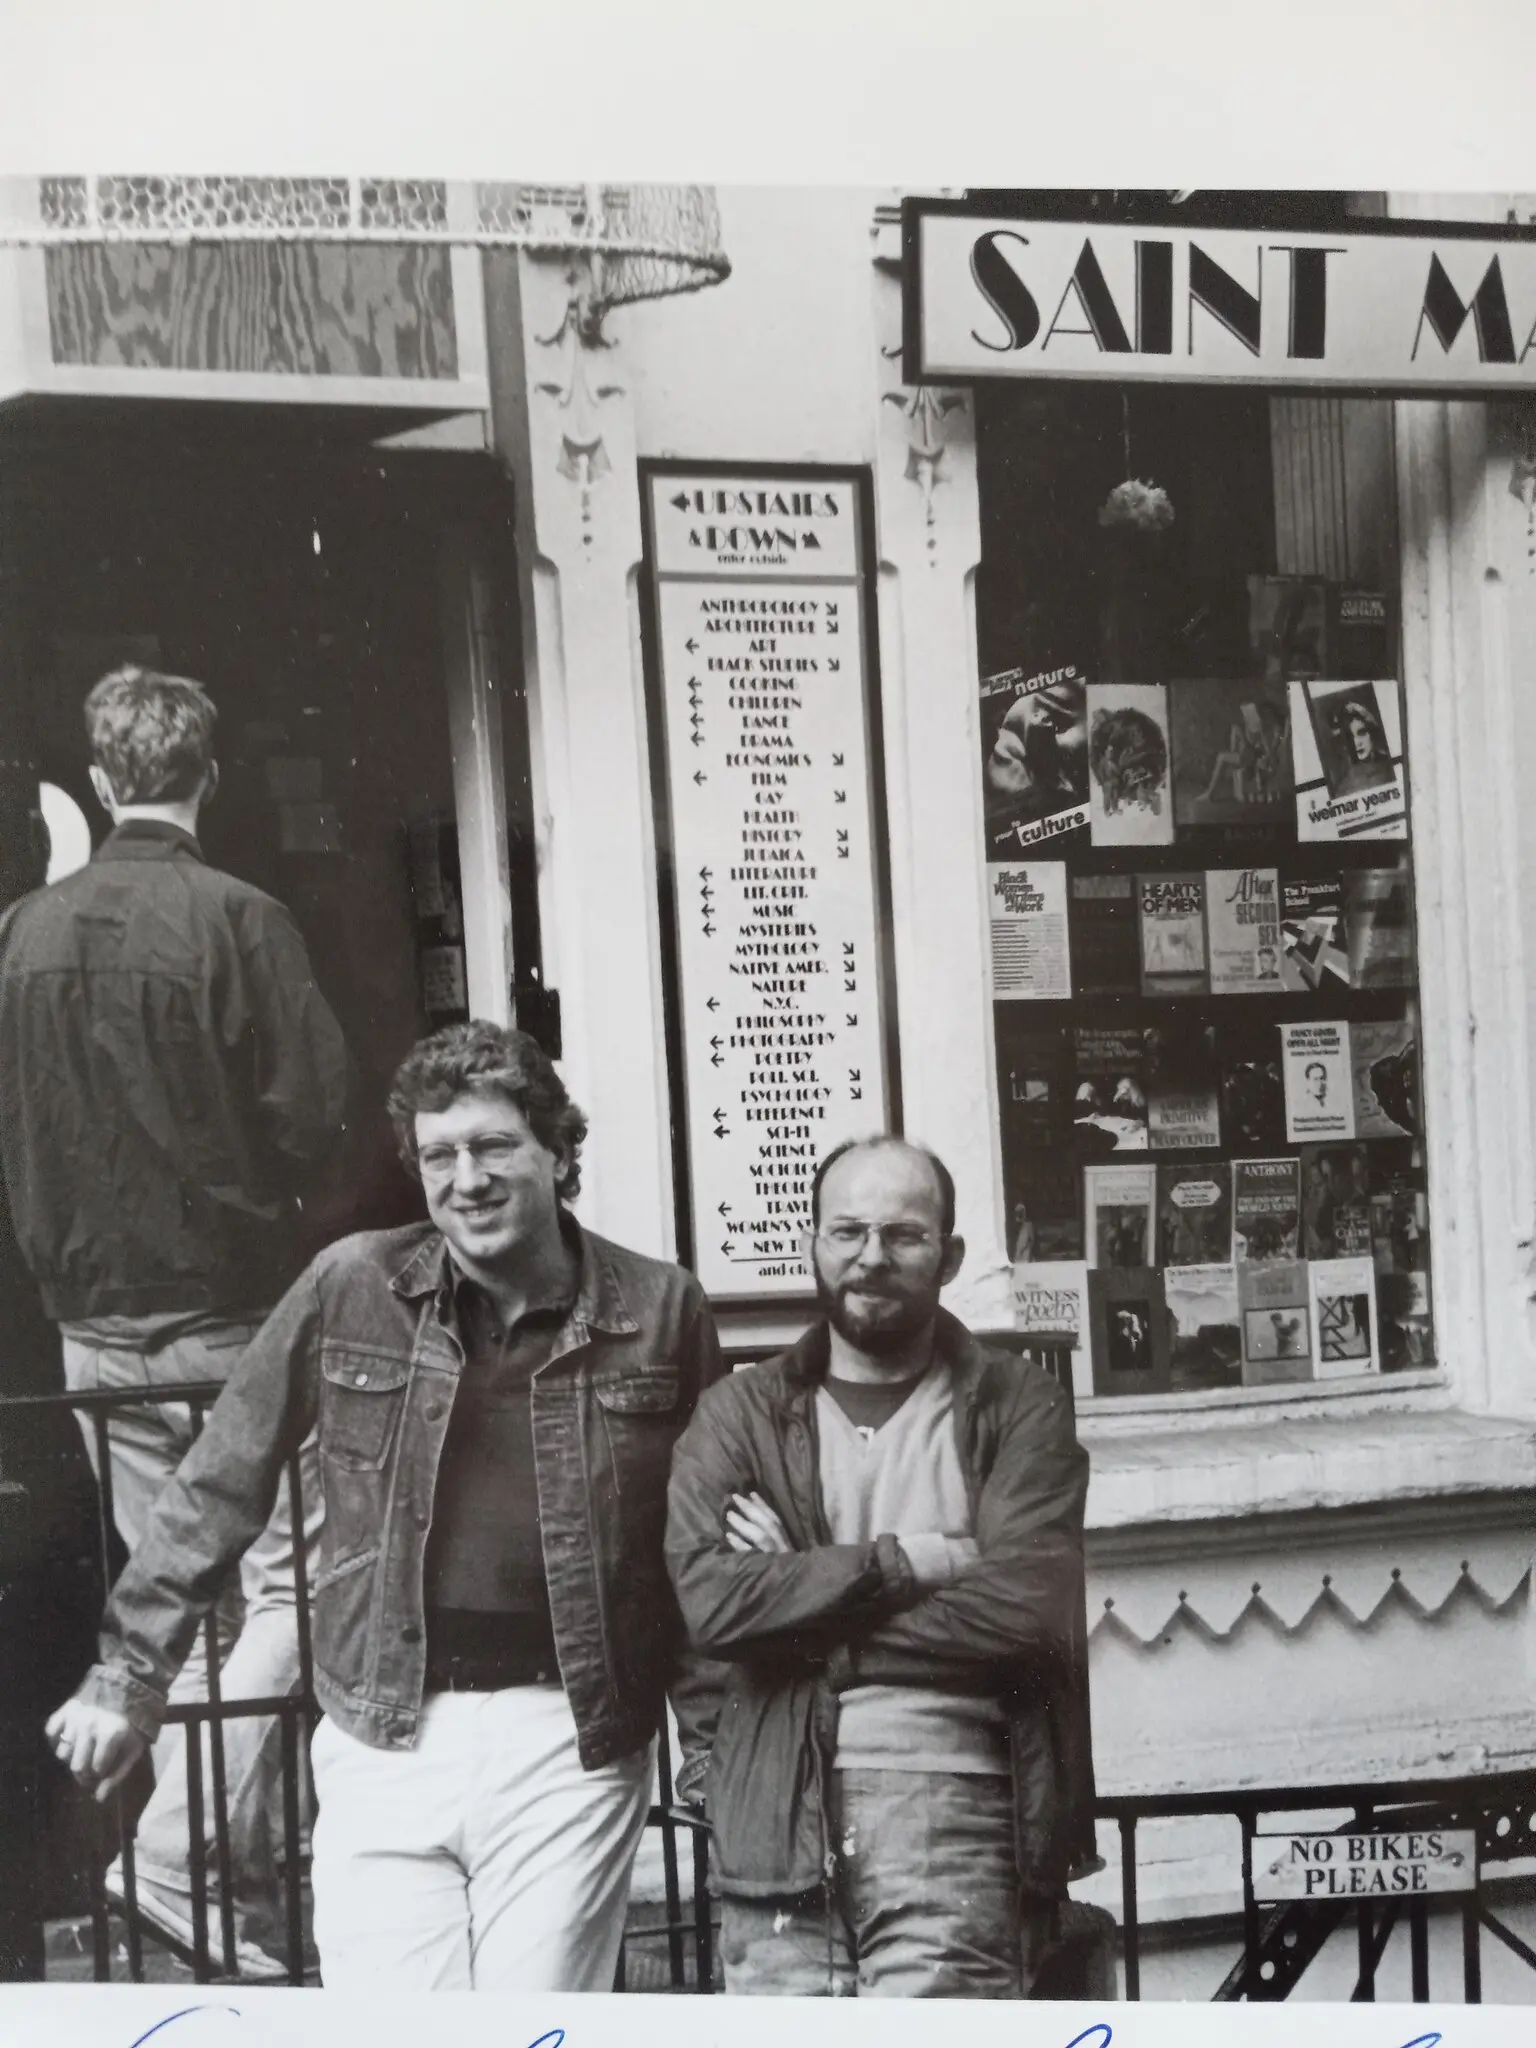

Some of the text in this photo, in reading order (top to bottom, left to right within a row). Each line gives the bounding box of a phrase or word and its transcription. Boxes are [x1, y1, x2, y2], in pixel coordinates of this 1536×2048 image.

[969, 230, 1348, 359] SAINT
[694, 489, 839, 517] UPSTAIRS
[689, 526, 797, 552] & DOWN
[717, 554, 787, 565] enter outside
[700, 599, 818, 614] ANTHROPOLOGY
[705, 619, 815, 634] ARCHITECTURE
[749, 639, 776, 653] ART
[708, 656, 818, 672] BLACK STUDIES
[729, 677, 798, 691] COOKING
[1014, 664, 1078, 697] nature
[728, 696, 802, 710] CHILDREN
[742, 715, 789, 729] DANCE
[740, 734, 794, 748] DRAMA
[726, 753, 812, 767] ECONOMICS
[751, 772, 787, 786] FILM
[755, 791, 783, 804] GAY
[1307, 799, 1359, 823] weimar
[1361, 787, 1401, 811] years
[744, 810, 800, 824] HEALTH
[1021, 809, 1086, 844] culture
[742, 829, 802, 843] HISTORY
[744, 848, 805, 862] JUDAICA
[730, 866, 817, 881] LITERATURE
[743, 885, 808, 899] LIT. CRIT.
[1142, 883, 1201, 898] HEARTS
[1225, 870, 1275, 902] After
[753, 904, 797, 918] MUSIC
[1142, 898, 1201, 913] OF MEN
[739, 923, 817, 937] MYSTERIES
[735, 942, 820, 956] MYTHOLOGY
[729, 960, 829, 975] NATIVE AMER.
[752, 979, 806, 993] NATURE
[736, 1013, 826, 1029] PHILOSOPHY
[730, 1032, 836, 1048] PHOTOGRAPHY
[755, 1052, 812, 1066] POETRY
[792, 1069, 820, 1083] SCI.
[741, 1087, 832, 1103] PSYCHOLOGY
[746, 1106, 826, 1121] REFERENCE
[767, 1125, 810, 1140] SCI-FI
[759, 1143, 816, 1158] SCIENCE
[1244, 1163, 1294, 1177] ANTHONY
[767, 1200, 811, 1214] TRAVE
[726, 1219, 792, 1235] WOMEN'S
[753, 1240, 785, 1254] NEW
[758, 1263, 786, 1277] and
[1014, 1287, 1081, 1302] WITNESS
[1290, 1833, 1443, 1864] NO BIKES
[1304, 1864, 1428, 1895] PLEASE
